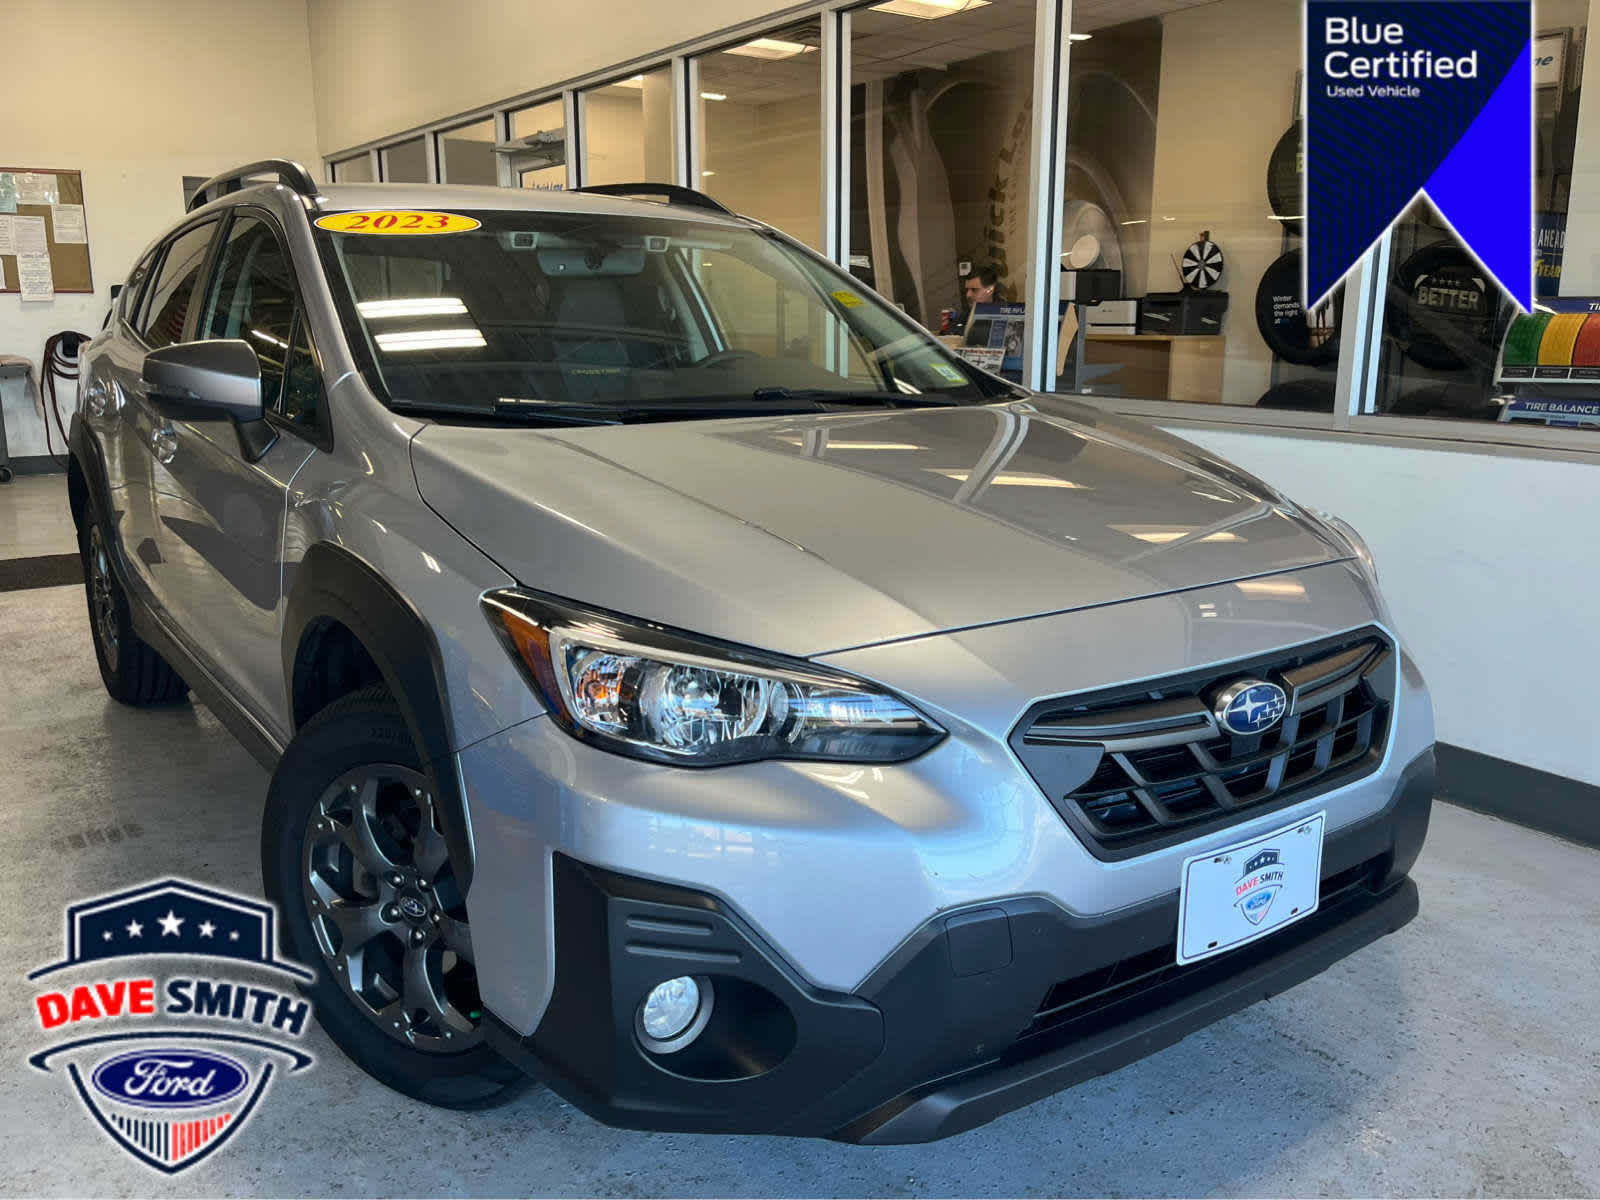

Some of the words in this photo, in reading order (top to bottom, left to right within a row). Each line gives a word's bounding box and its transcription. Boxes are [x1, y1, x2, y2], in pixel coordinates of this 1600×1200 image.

[344, 214, 449, 230] 2023
[1273, 302, 1301, 310] demands
[1417, 286, 1480, 311] BETTER
[1525, 401, 1548, 412] TIRE
[1548, 403, 1600, 415] BALANCE
[1235, 876, 1260, 897] DAVE
[1260, 871, 1283, 884] SMITH
